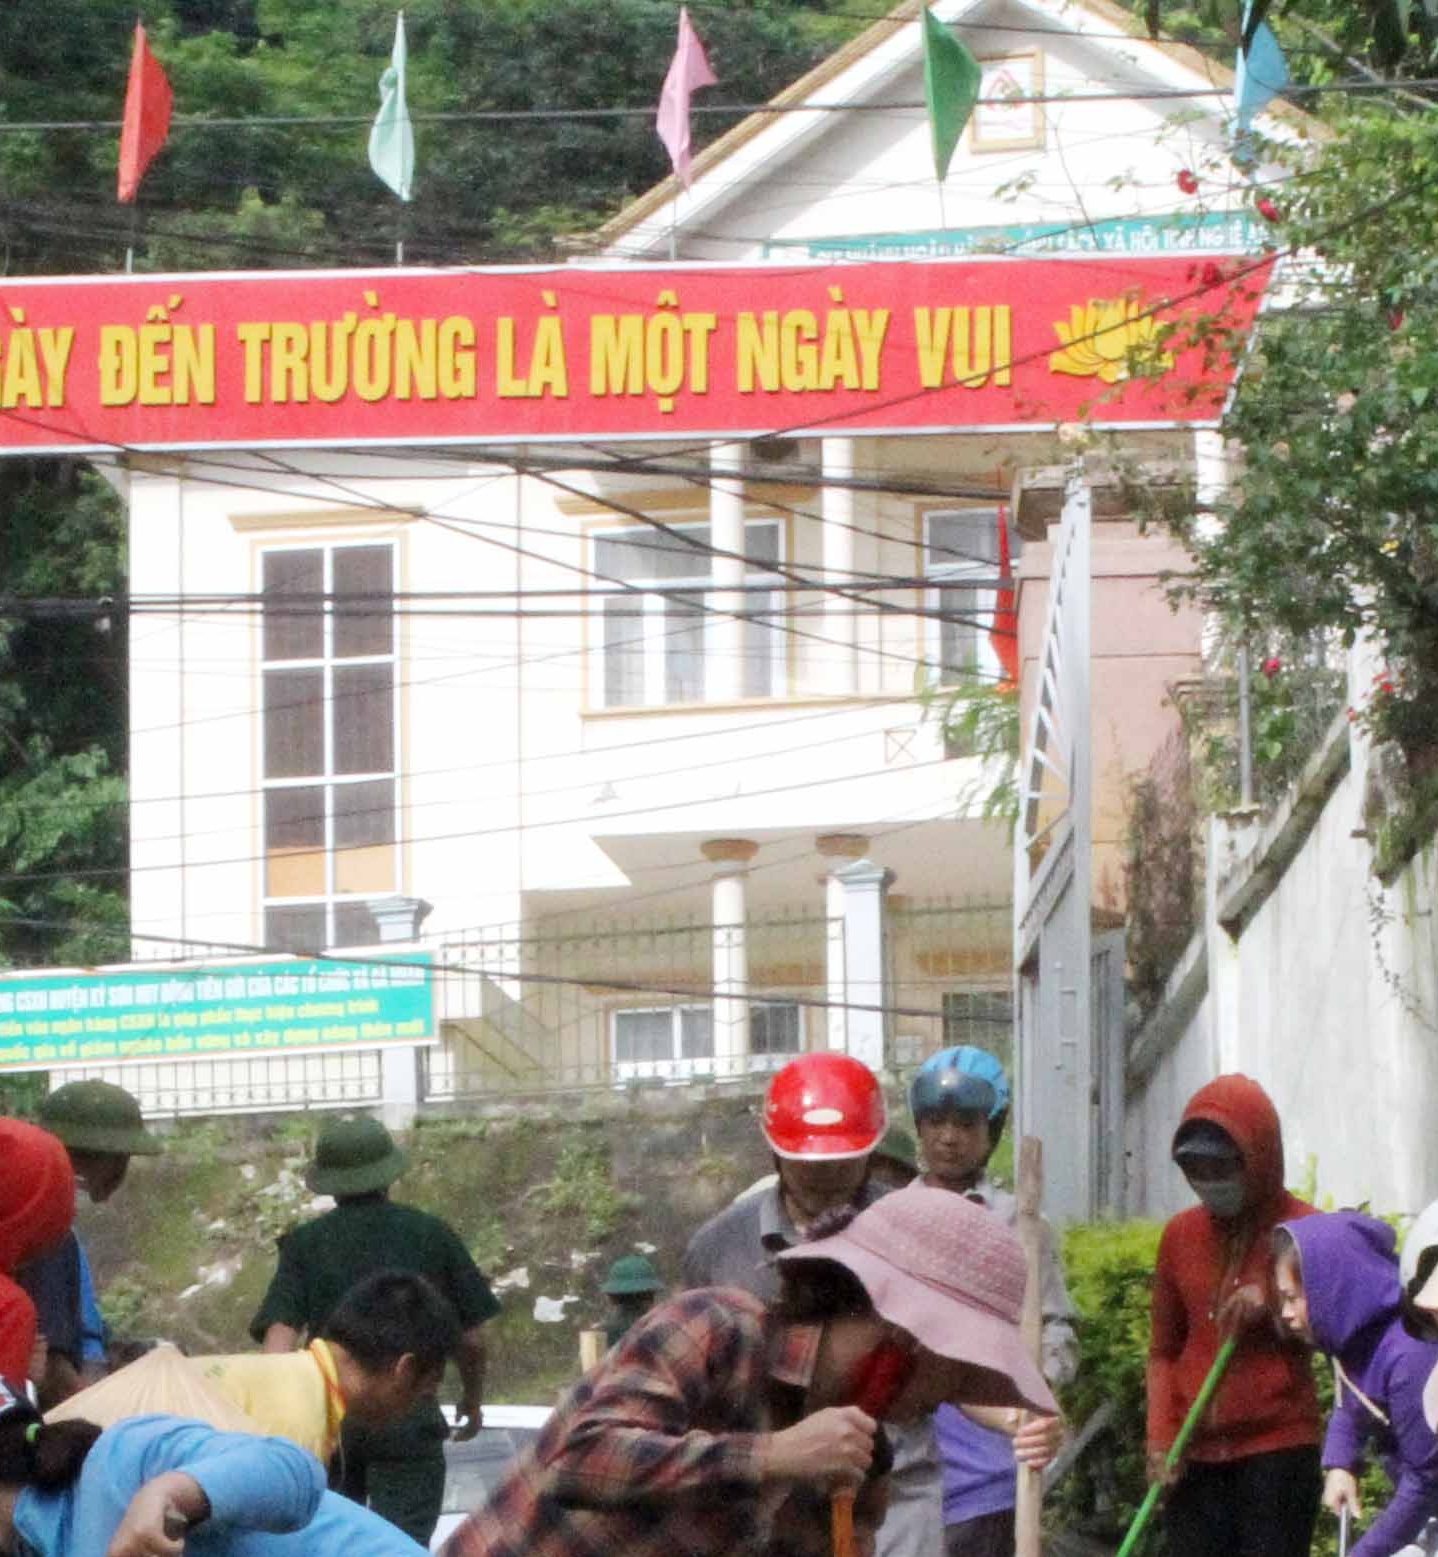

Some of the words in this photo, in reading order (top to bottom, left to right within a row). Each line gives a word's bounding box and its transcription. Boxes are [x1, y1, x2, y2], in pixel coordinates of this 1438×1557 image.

[98, 294, 216, 406] ĐẾN
[237, 290, 476, 403] TRƯỜNG
[496, 291, 568, 397] LÀ
[590, 289, 717, 412] MỘT
[736, 285, 890, 392] NGÀY
[913, 304, 1012, 388] VUI
